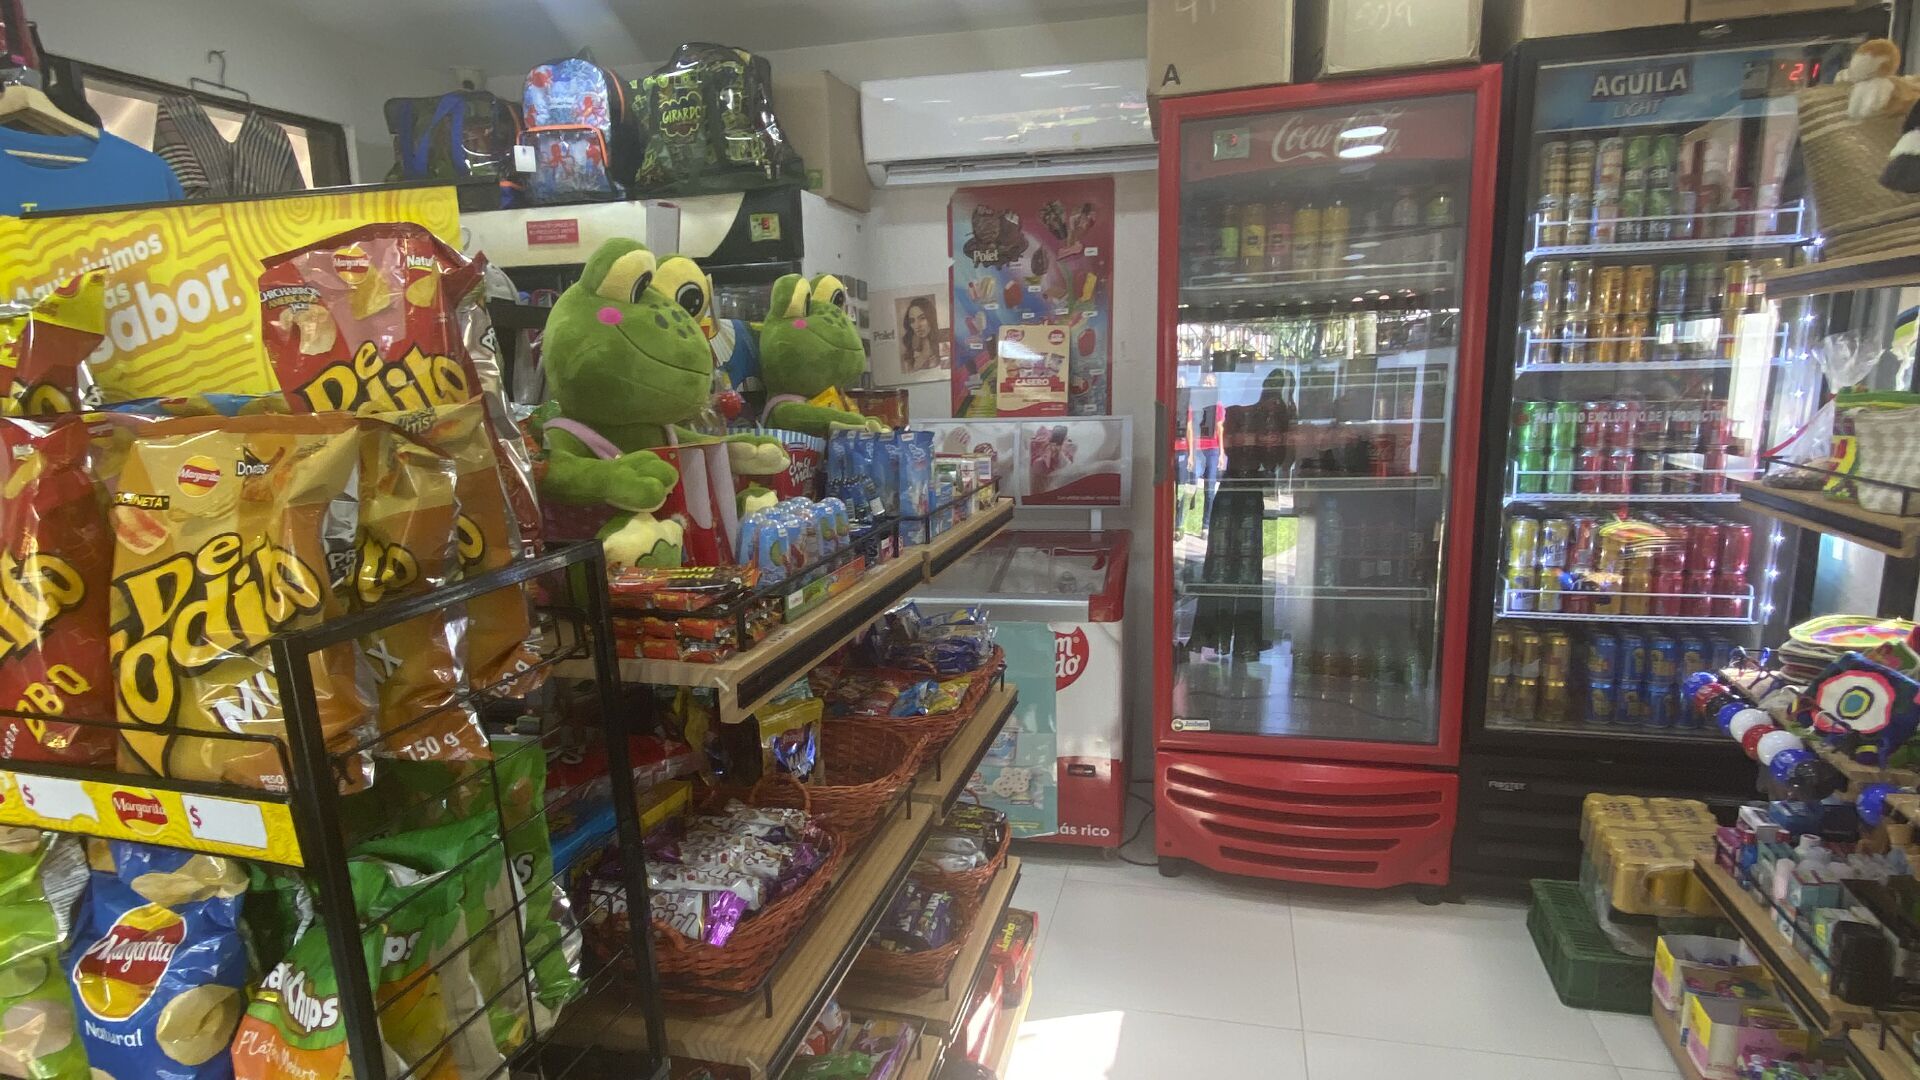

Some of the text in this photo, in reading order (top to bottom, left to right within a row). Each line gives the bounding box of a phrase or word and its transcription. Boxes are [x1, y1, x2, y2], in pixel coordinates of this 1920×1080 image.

[1161, 63, 1181, 86] A
[1592, 67, 1688, 96] AGUILA
[1613, 99, 1664, 119] LIGHT
[973, 249, 999, 262] Polet
[22, 784, 35, 806] $
[114, 800, 165, 818] Margarita
[189, 805, 202, 828] $
[1081, 822, 1110, 837] rico
[96, 934, 177, 973] Margarita
[85, 1020, 143, 1047] Natural
